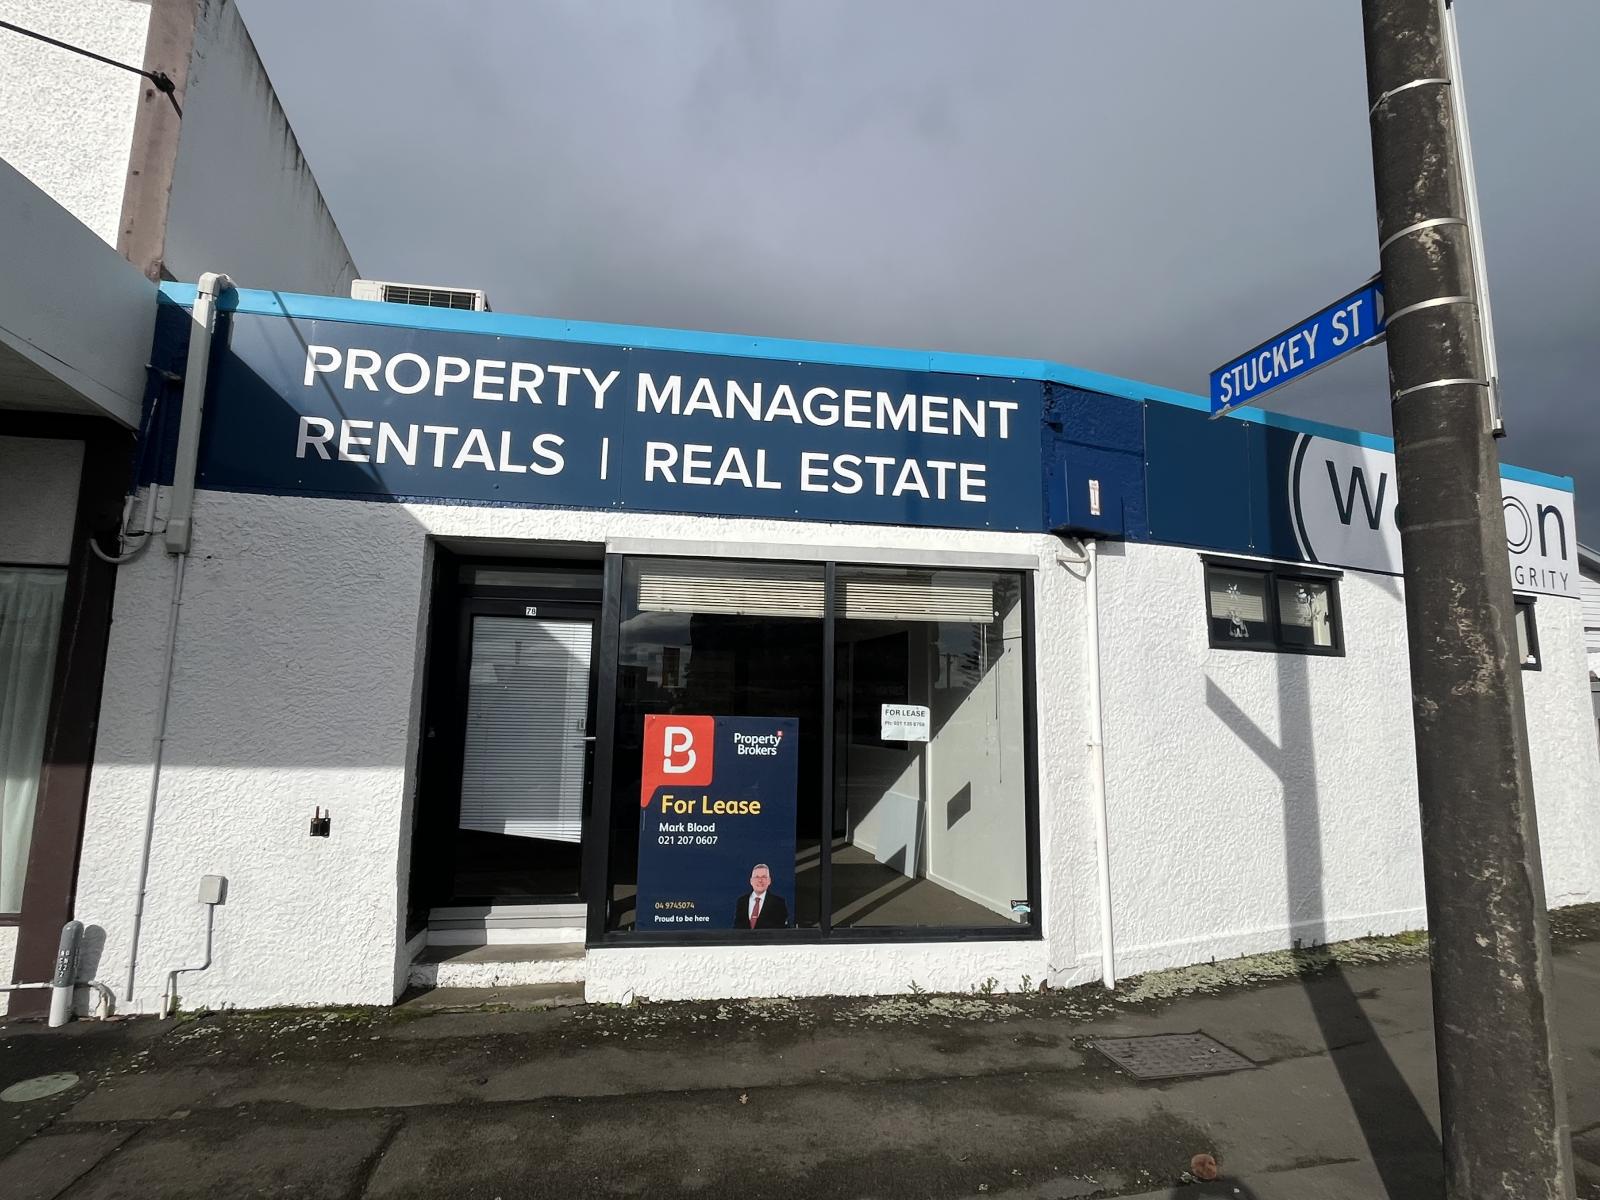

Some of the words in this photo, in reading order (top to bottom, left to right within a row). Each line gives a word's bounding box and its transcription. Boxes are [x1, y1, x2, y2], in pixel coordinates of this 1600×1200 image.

[1220, 324, 1319, 403] STUCKEY
[1332, 300, 1362, 346] ST
[303, 345, 621, 410] PROPERTY
[636, 372, 1020, 439] MANAGEMENT
[296, 416, 565, 476] RENTALS
[644, 441, 782, 490] REAL
[800, 451, 987, 503] ESTATE
[902, 709, 926, 717] LEASE
[733, 732, 782, 748] Property
[737, 744, 778, 756] Brokers
[661, 795, 697, 814] For
[702, 795, 761, 815] Lease
[658, 822, 685, 833] Mark
[687, 822, 716, 833] Blood
[658, 835, 675, 845] 021
[677, 835, 694, 845] 207
[695, 835, 719, 845] 0607
[654, 901, 664, 910] 04
[654, 914, 675, 923] Proud
[684, 914, 694, 922] be
[694, 914, 710, 922] here
